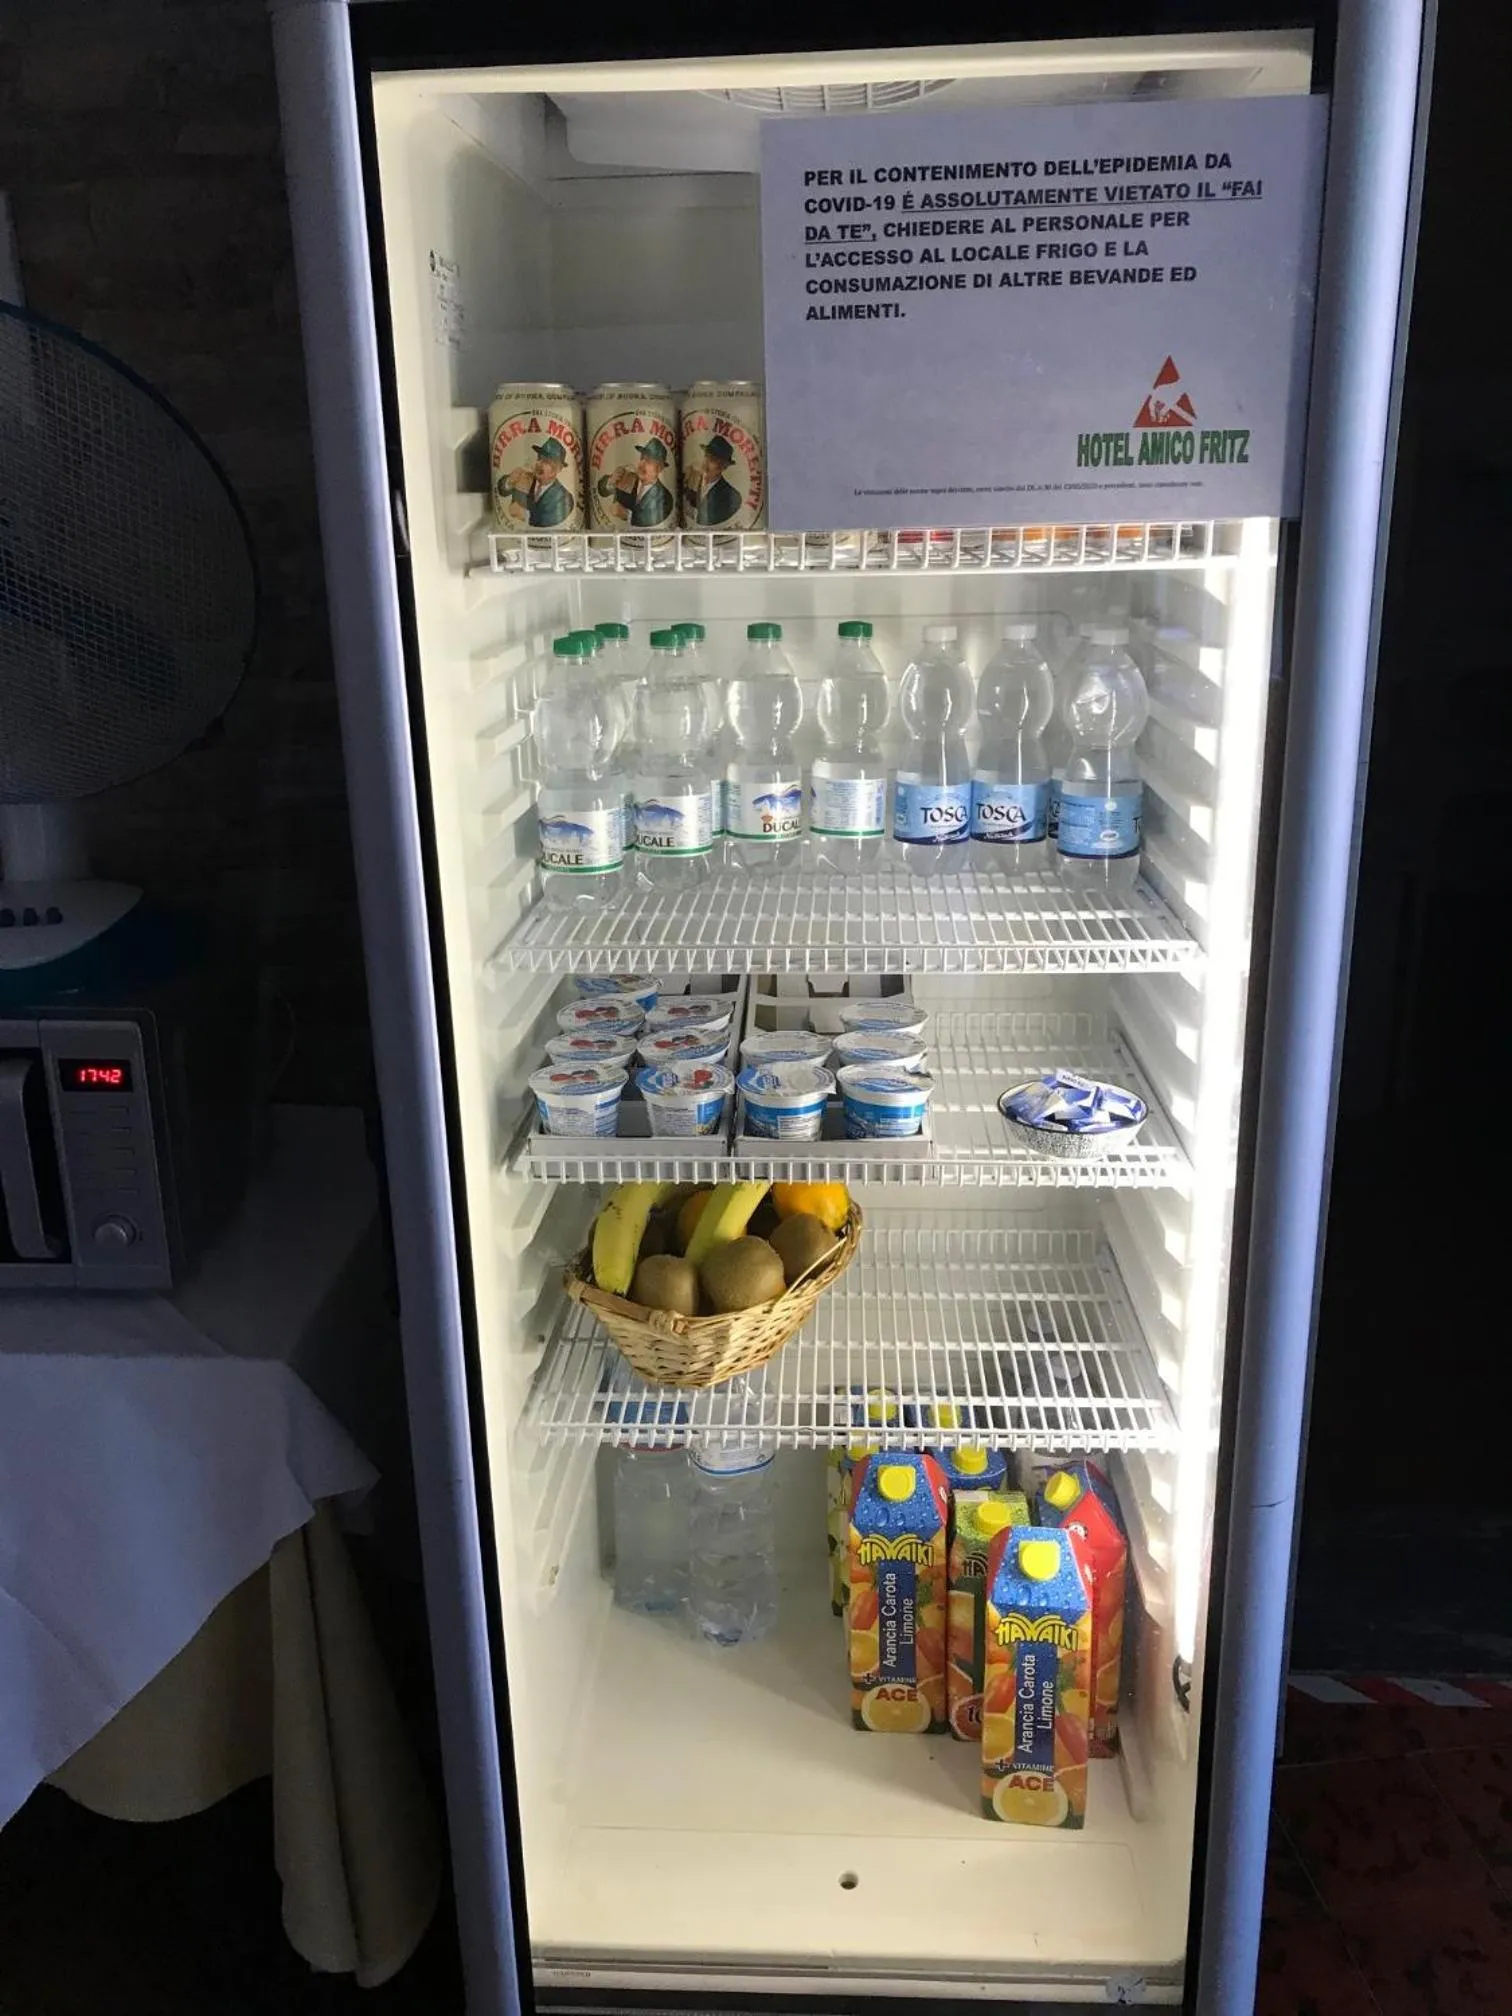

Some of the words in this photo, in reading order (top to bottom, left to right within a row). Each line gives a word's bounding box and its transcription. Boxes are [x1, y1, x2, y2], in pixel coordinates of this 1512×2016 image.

[804, 169, 844, 187] PER
[849, 168, 868, 185] IL
[873, 160, 1038, 184] CONTENIMENTO
[1043, 153, 1199, 177] DELL'EPIDEMIA
[1204, 152, 1232, 170] DA
[804, 194, 896, 215] COVID-19
[919, 186, 1100, 210] ASSOLUTAMENTE
[1103, 182, 1192, 203] VIETATO
[1197, 181, 1216, 199] IL
[804, 225, 832, 242] DA
[883, 218, 985, 238] CHIEDERE
[990, 217, 1017, 235] AL
[1022, 212, 1145, 233] PERSONALE
[1150, 211, 1190, 229] PER
[805, 248, 914, 269] L'ACCESSO
[919, 247, 946, 265] AL
[951, 244, 1030, 263] LOCALE
[1035, 241, 1098, 260] FRIGO
[1104, 241, 1117, 257] E
[1123, 239, 1149, 257] LA
[805, 273, 967, 295] CONSUMAZIONE
[972, 272, 993, 289] DI
[998, 270, 1063, 288] ALTRE
[1069, 267, 1165, 286] BEVANDE
[1169, 266, 1197, 282] ED
[805, 302, 906, 321] ALIMENTI.
[493, 417, 543, 468] BIRRA
[592, 418, 645, 470] BIRRA
[1076, 431, 1134, 467] HOTEL
[1138, 430, 1194, 467] AMICO
[1198, 429, 1250, 465] FRITZ
[975, 803, 1028, 824] TOSCA
[80, 1068, 122, 1084] 1742
[857, 1533, 934, 1568] HAWAIKI
[881, 1572, 897, 1617] Carota
[899, 1598, 914, 1645] Limone
[995, 1612, 1079, 1652] HAWAIKI
[882, 1619, 897, 1668] Arancia
[1018, 1654, 1036, 1699] Carota
[875, 1687, 918, 1703] ACE
[1037, 1680, 1054, 1730] Limone
[1017, 1703, 1034, 1754] Arancia
[1008, 1774, 1055, 1793] ACE
[1011, 1762, 1055, 1772] VITAMINE
